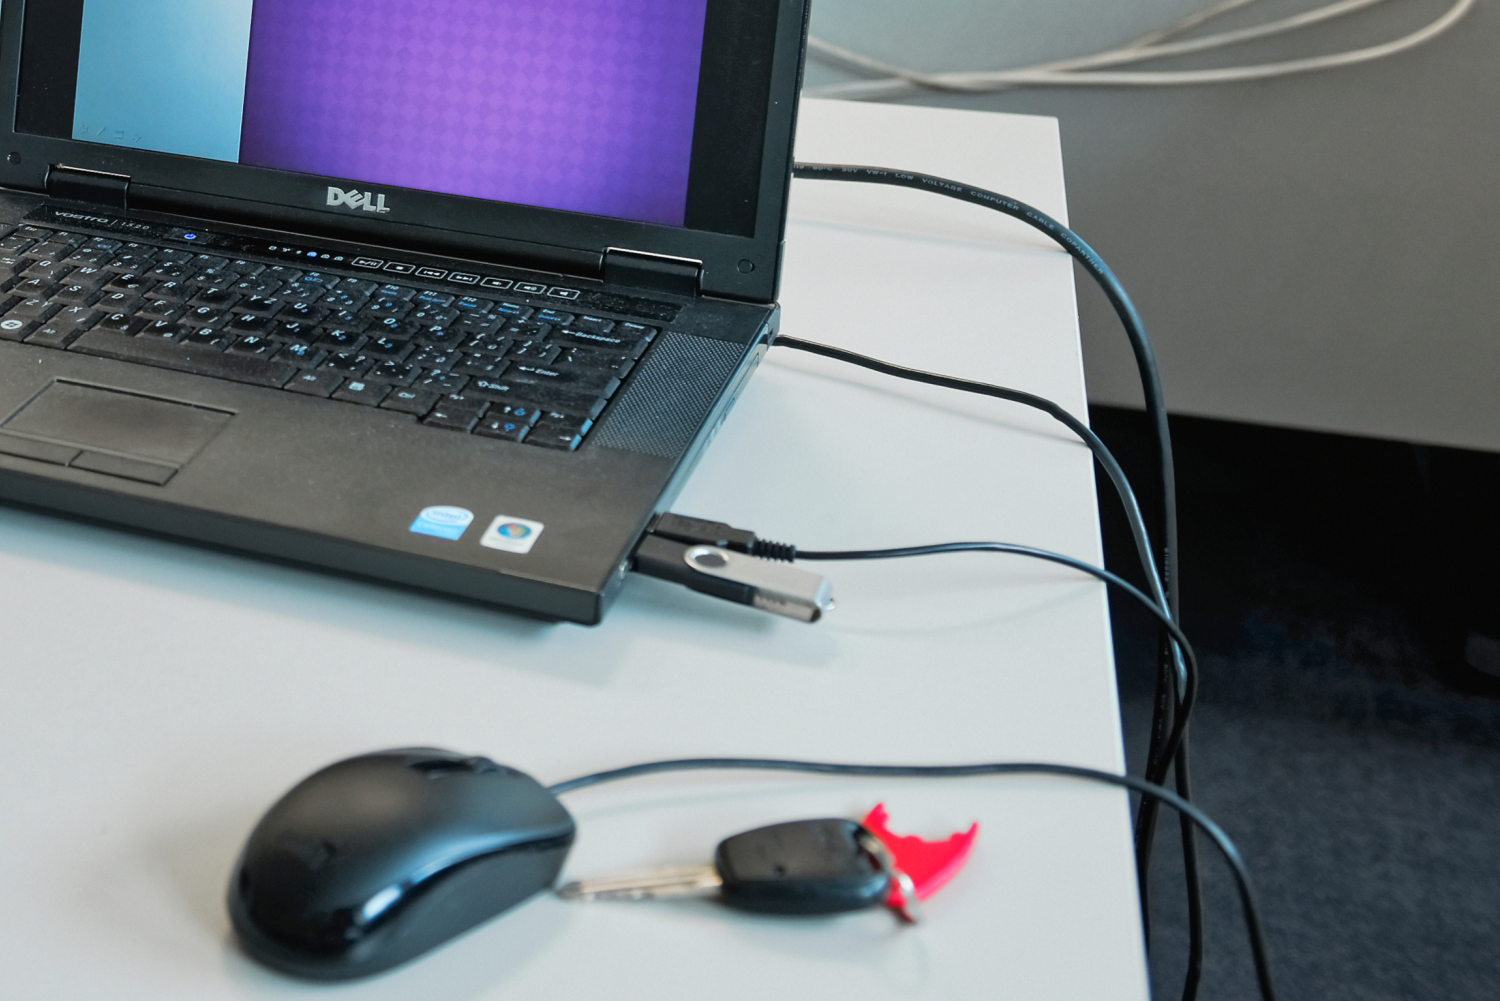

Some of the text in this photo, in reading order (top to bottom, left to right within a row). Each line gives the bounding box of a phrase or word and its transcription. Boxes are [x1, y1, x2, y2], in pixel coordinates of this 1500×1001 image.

[326, 186, 391, 214] DELL
[922, 178, 963, 193] VOLTAGE
[970, 190, 1020, 211] COMPUTER
[1026, 211, 1055, 230] CABLE
